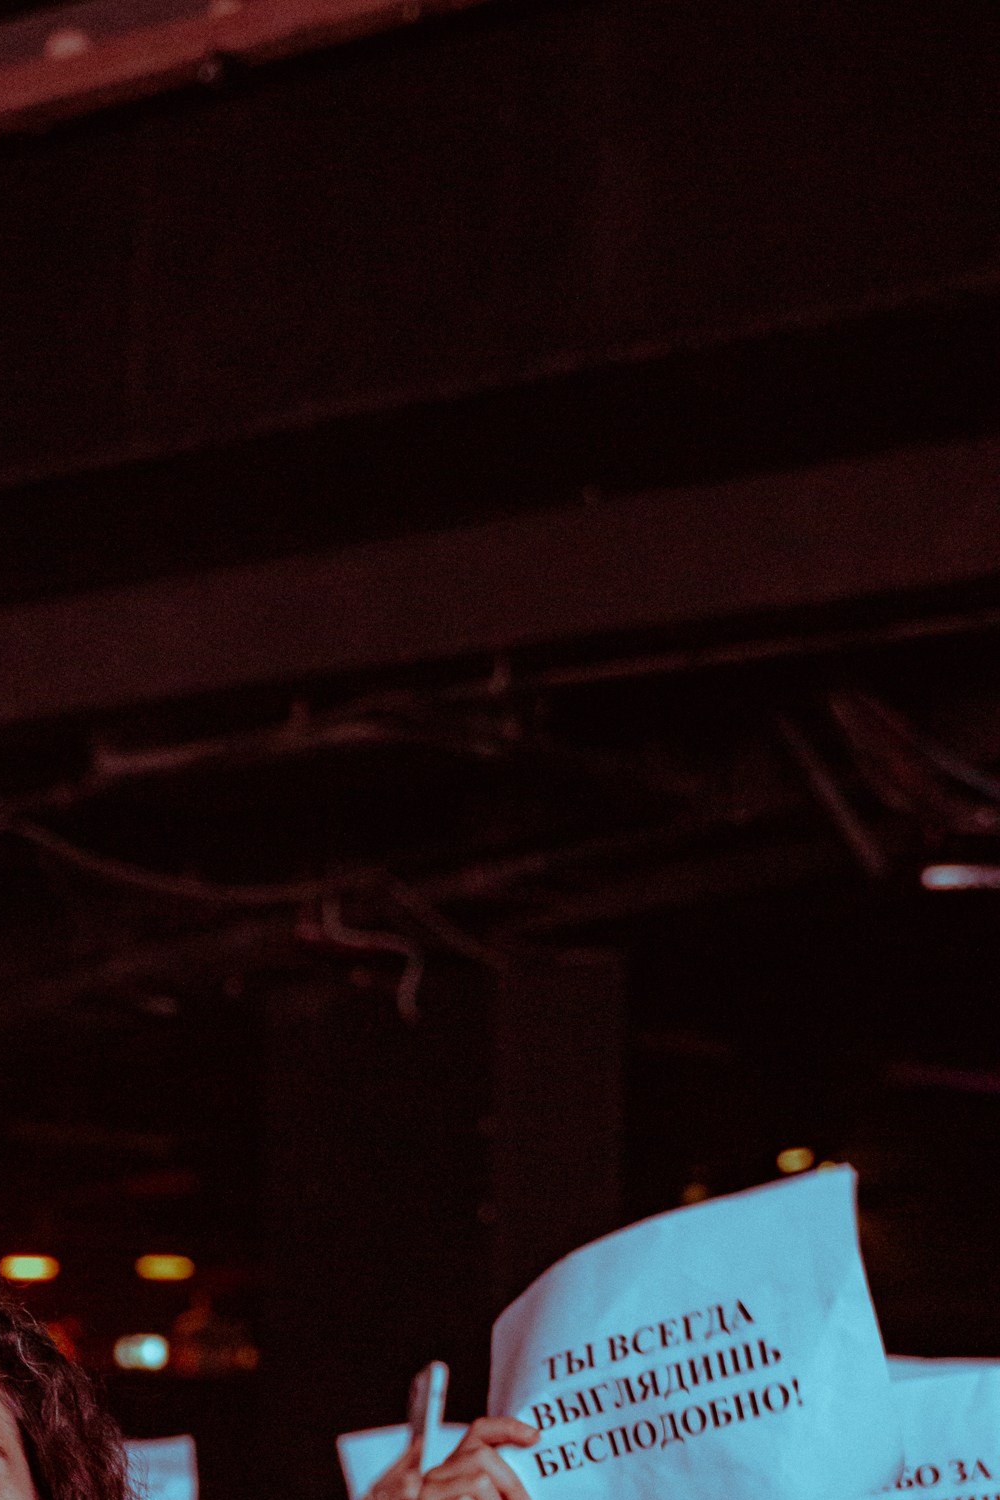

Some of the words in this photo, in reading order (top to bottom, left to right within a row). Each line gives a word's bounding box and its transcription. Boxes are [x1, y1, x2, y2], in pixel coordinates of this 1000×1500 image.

[541, 1343, 595, 1381] ТЫ
[607, 1299, 754, 1362] ВСЕГДА
[530, 1339, 782, 1432] ВЫГЛЯДИШЬ
[532, 1377, 803, 1479] БЕСПОДОБНО!
[948, 1458, 992, 1485] ЗА
